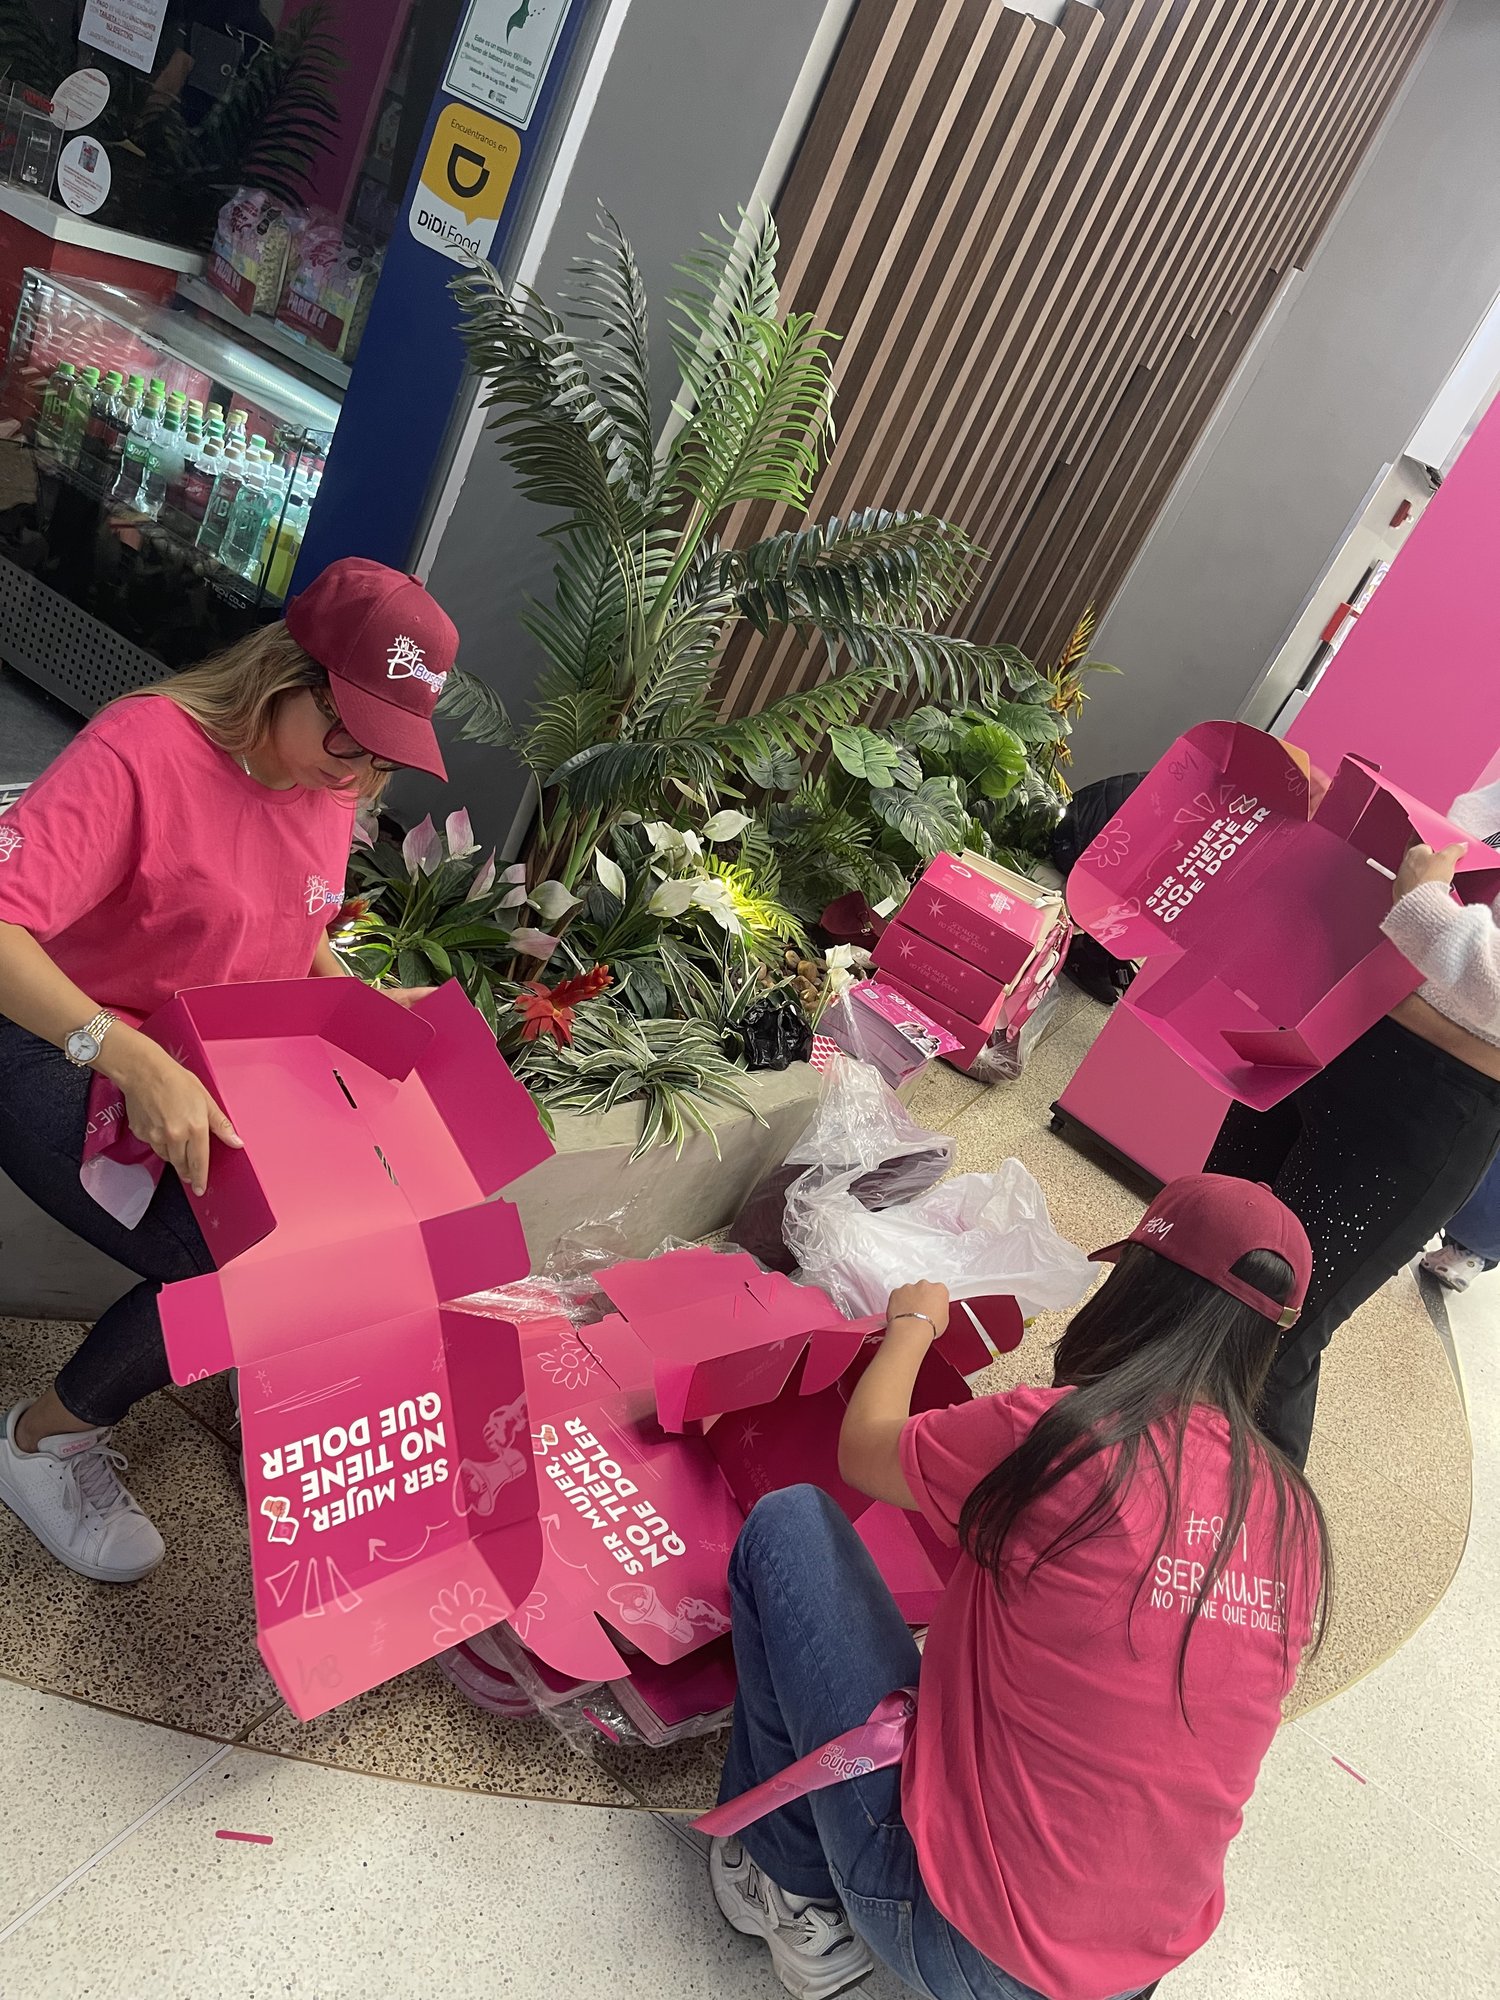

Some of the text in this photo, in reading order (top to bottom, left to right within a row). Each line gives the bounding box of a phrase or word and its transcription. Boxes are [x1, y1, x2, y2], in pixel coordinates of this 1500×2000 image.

[498, 144, 508, 153] en
[417, 209, 481, 255] DiDi Food
[1145, 817, 1231, 908] SER MUJER,
[1152, 820, 1242, 917] NO TIENE
[1163, 807, 1271, 923] QUE DOLER
[1142, 1216, 1175, 1241] #8M
[260, 1392, 441, 1480] QUE DOLER
[300, 1421, 446, 1503] NO TIENE
[303, 1458, 449, 1532] SER MUJER,
[545, 1456, 644, 1576] SER MUJER,
[561, 1448, 669, 1568] NO TIENE
[564, 1416, 686, 1556] QUE DOLER
[1151, 1588, 1174, 1609] NO
[1222, 1603, 1247, 1625] QUE
[1155, 1555, 1286, 1614] SER MUJER
[820, 1752, 872, 1777] apina
